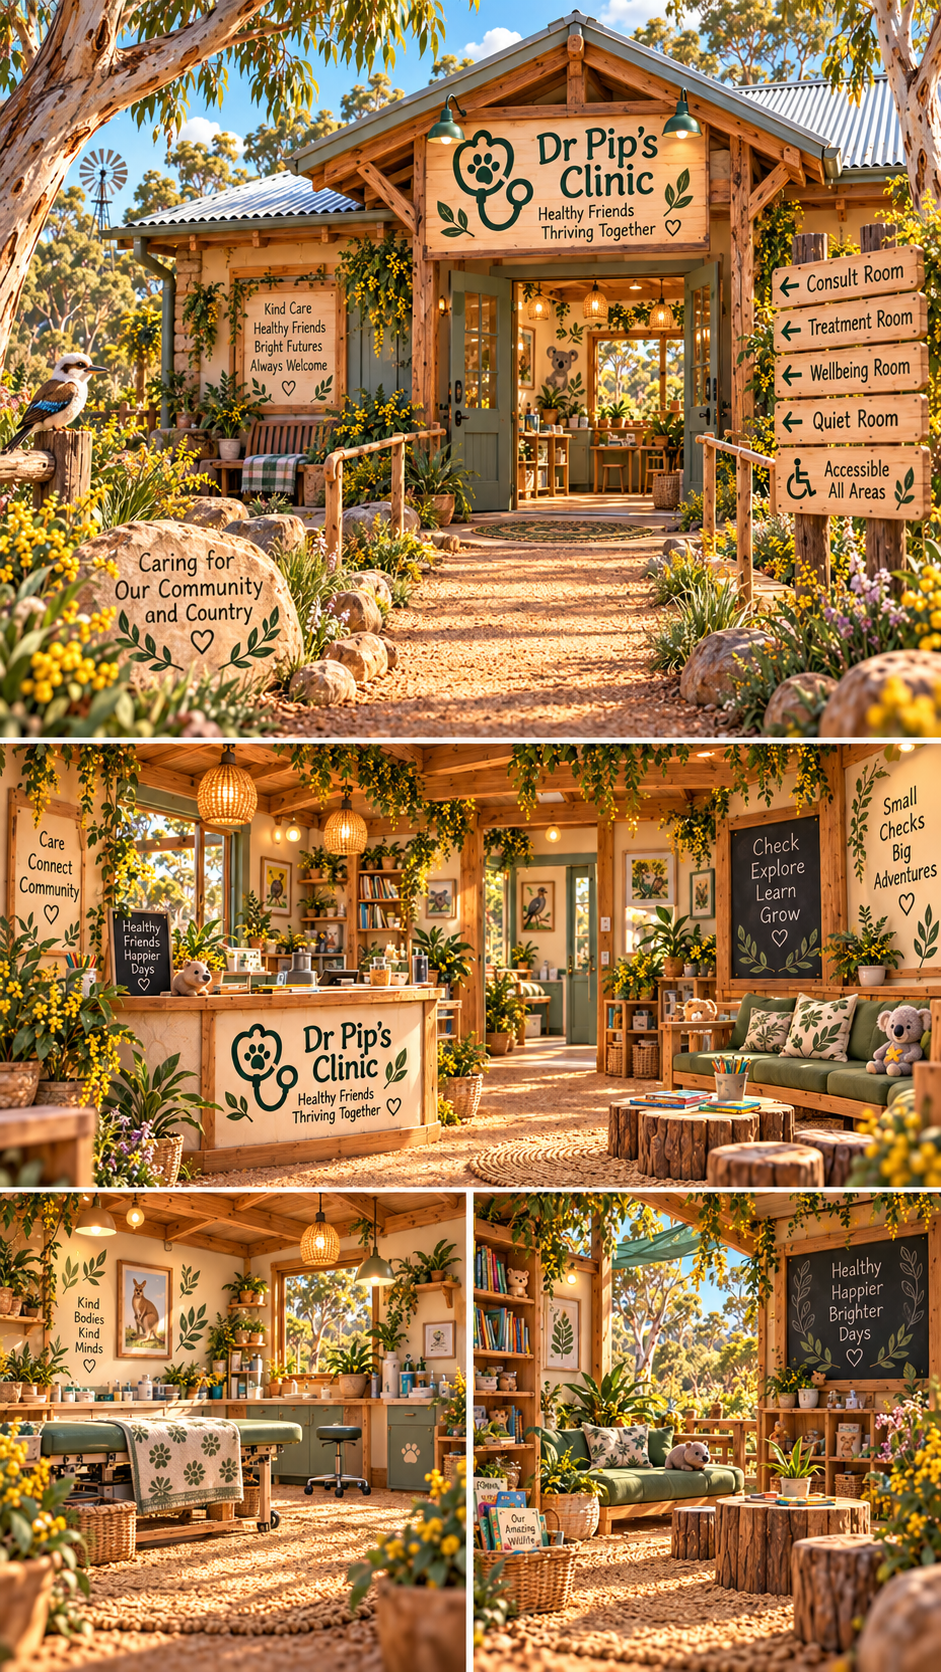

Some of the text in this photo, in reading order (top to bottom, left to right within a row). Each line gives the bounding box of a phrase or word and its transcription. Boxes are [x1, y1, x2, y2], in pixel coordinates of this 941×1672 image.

[537, 125, 658, 169] Dr Pip's
[560, 164, 654, 198] Clinic
[539, 203, 634, 223] Healthy Friends
[542, 221, 656, 242] Thriving Together
[807, 265, 903, 292] Consult Room
[265, 301, 311, 314] Kind Care
[254, 320, 326, 337] Healthy Friends
[808, 310, 912, 335] Treatment Room
[255, 340, 322, 356] Bright Futures
[250, 359, 327, 375] Always Welcome
[811, 359, 910, 383] Wellbeing Room
[813, 409, 898, 432] Quiet Room
[825, 460, 889, 477] Accessible
[829, 482, 885, 499] All Areas
[139, 550, 234, 576] Caring for
[115, 577, 263, 600] Our Community
[146, 603, 252, 625] and Country
[884, 785, 917, 815] Small
[880, 810, 924, 841] Checks
[40, 831, 64, 850] Care
[753, 833, 799, 855] Check
[893, 843, 910, 863] Big
[28, 853, 72, 874] Connect
[752, 859, 804, 882] Explore
[874, 864, 937, 889] Adventures
[20, 877, 79, 902] Community
[757, 885, 795, 901] Learn
[761, 907, 800, 923] Grow
[123, 921, 161, 936] Healthy
[124, 935, 160, 947] Friends
[125, 950, 160, 963] Happier
[132, 964, 154, 977] Days
[303, 1020, 392, 1055] Dr Pip's
[313, 1054, 378, 1083] Clinic
[299, 1087, 374, 1106] Healthy Friends
[292, 1104, 381, 1124] Thriving Together
[832, 1257, 882, 1279] Healthy
[832, 1282, 883, 1303] Happier
[78, 1297, 99, 1309] Kind
[75, 1311, 104, 1324] Bodies
[830, 1303, 883, 1325] Brighter
[79, 1327, 99, 1339] Kind
[840, 1327, 870, 1345] Days
[75, 1342, 103, 1354] Minds
[511, 1514, 525, 1523] Our
[506, 1524, 535, 1534] Amazing
